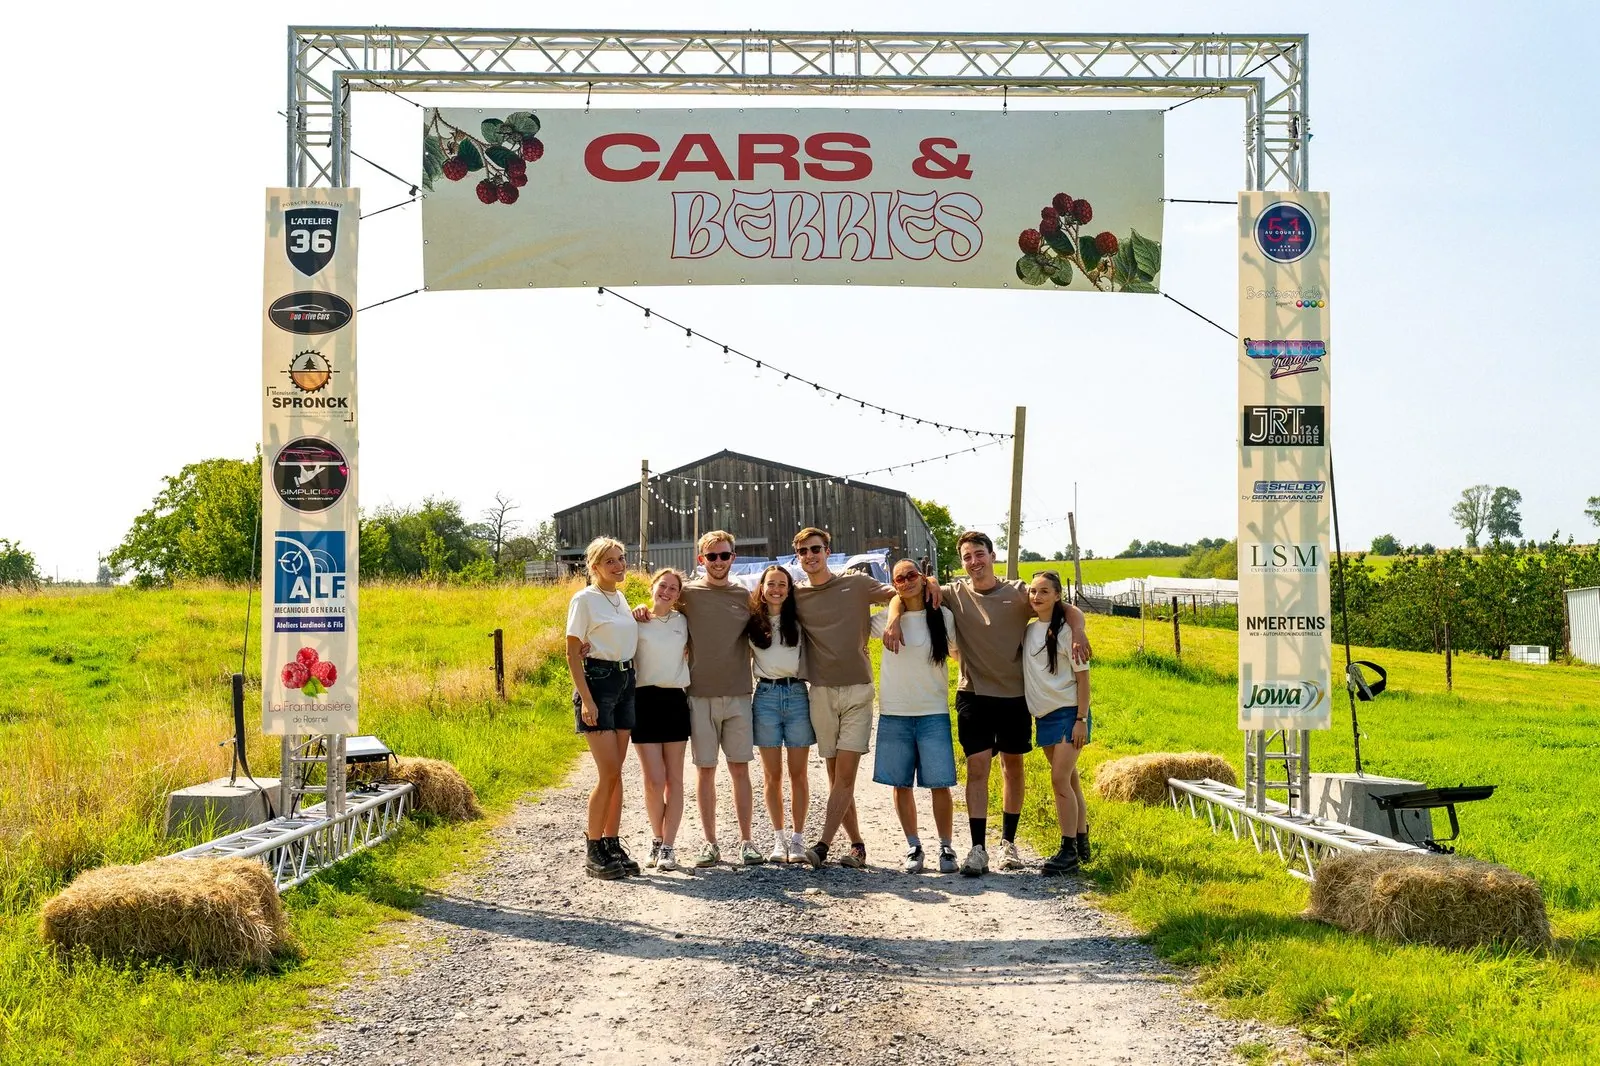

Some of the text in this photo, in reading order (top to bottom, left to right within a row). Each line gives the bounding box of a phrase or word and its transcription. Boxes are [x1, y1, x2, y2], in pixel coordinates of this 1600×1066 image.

[584, 132, 973, 182] CARS &
[671, 188, 983, 262] BERRIES
[1266, 218, 1304, 242] 51
[290, 229, 332, 254] 36
[316, 312, 330, 320] Cars
[272, 398, 348, 408] SPRONCK
[1249, 408, 1305, 442] JRT
[1300, 425, 1319, 434] 126
[1268, 435, 1319, 444] SOUDURE
[1251, 545, 1318, 567] LSM
[290, 576, 345, 598] ALF
[1246, 617, 1325, 630] NMERTENS
[268, 700, 351, 712] La Framboisière
[1244, 685, 1302, 708] Jowa
